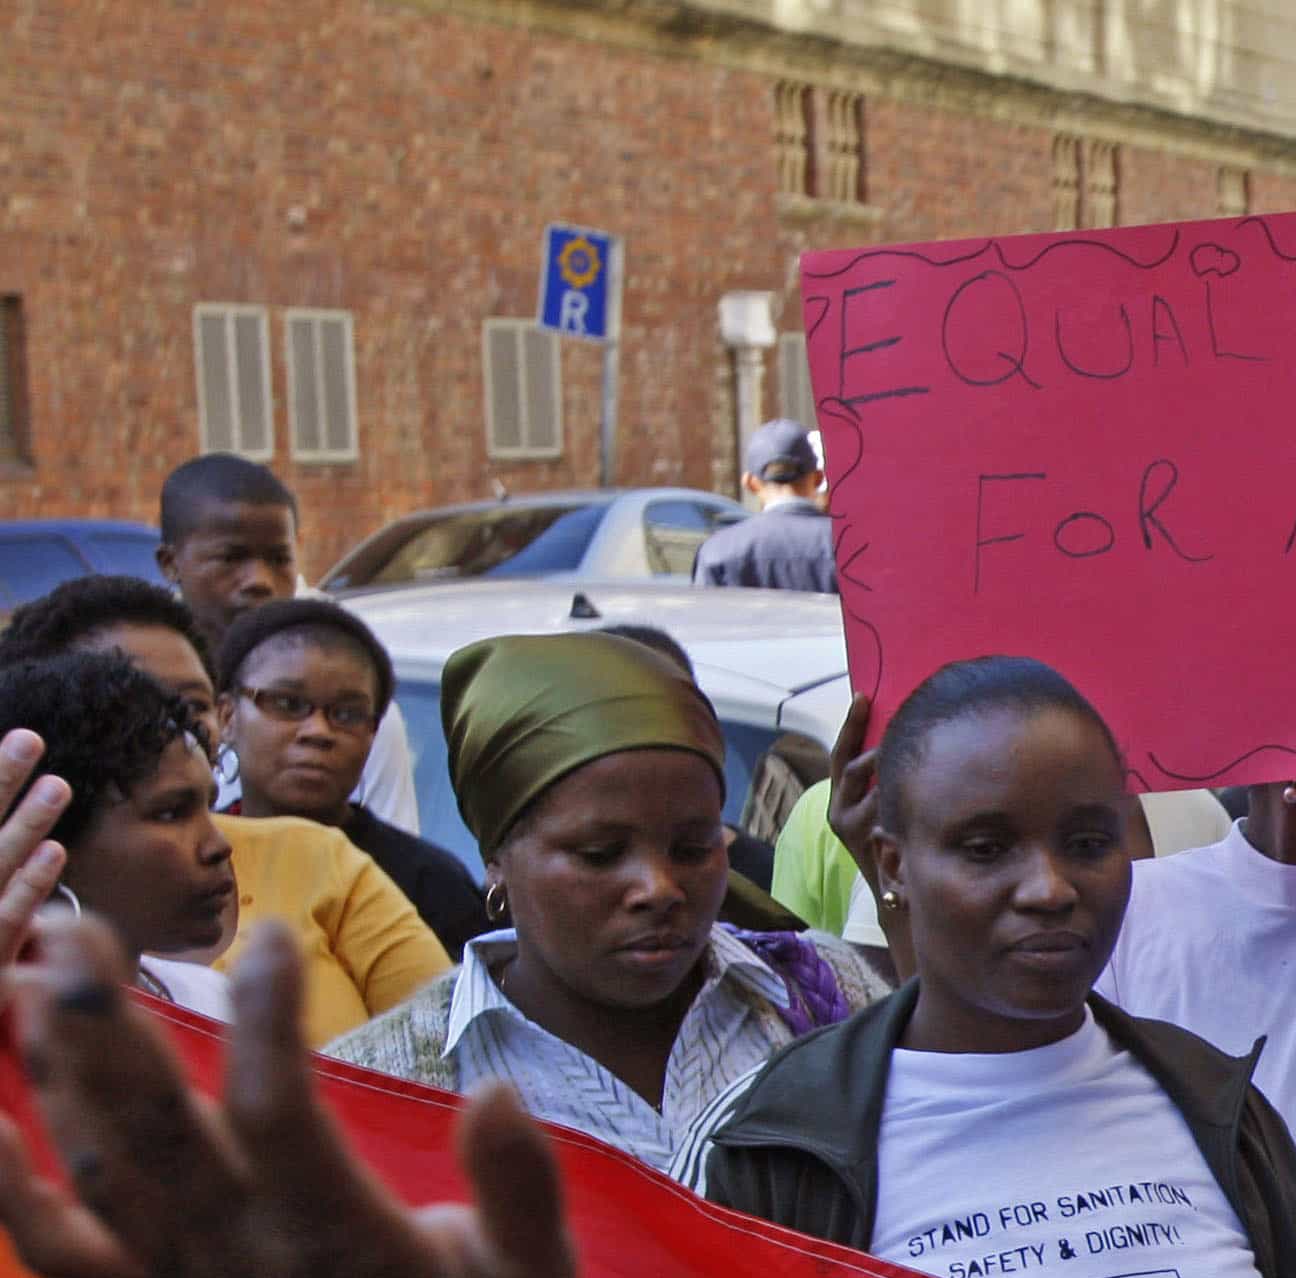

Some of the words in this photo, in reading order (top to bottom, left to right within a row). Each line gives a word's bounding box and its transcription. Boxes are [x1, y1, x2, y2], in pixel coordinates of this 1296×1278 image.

[560, 289, 589, 335] R
[838, 270, 1270, 404] EQUAL
[908, 1212, 990, 1258] STAND
[1000, 1198, 1049, 1232] FOR
[1058, 1238, 1078, 1261] &
[1087, 1221, 1184, 1256] DIGNITY!
